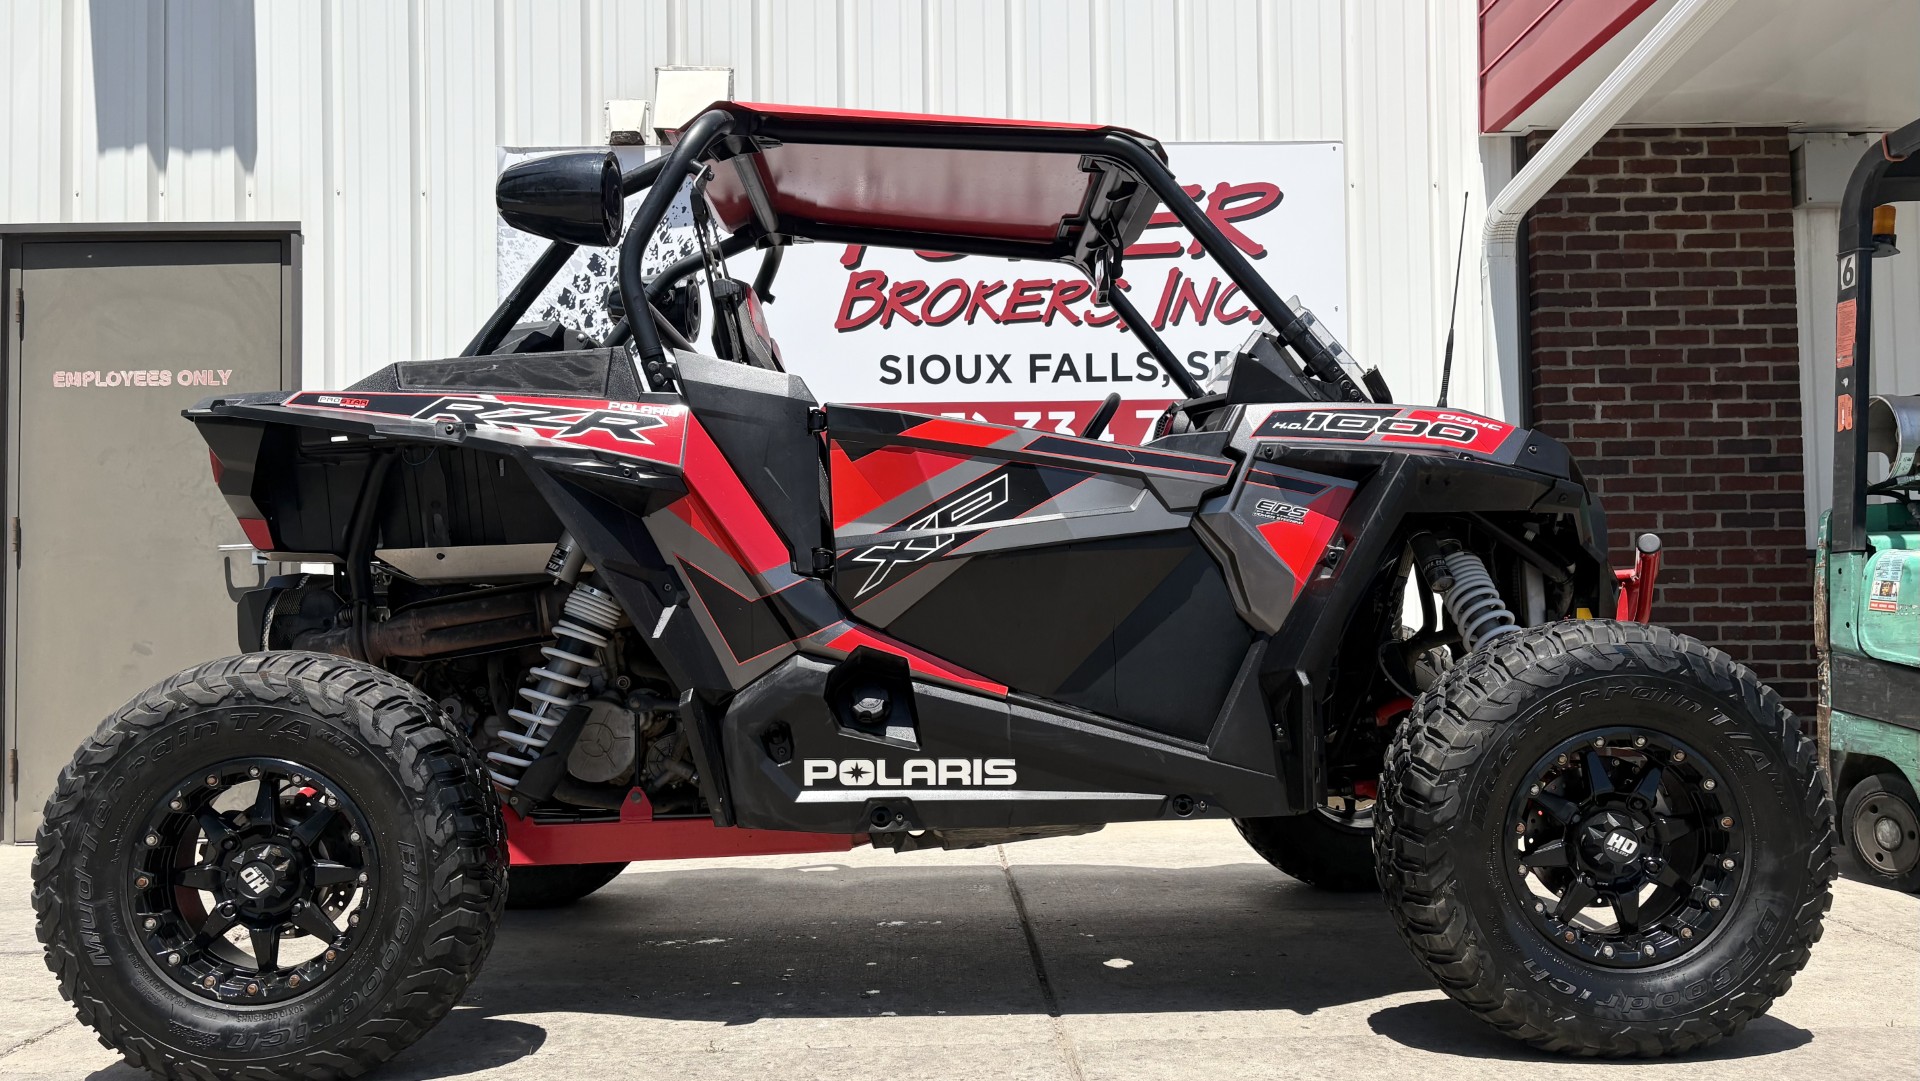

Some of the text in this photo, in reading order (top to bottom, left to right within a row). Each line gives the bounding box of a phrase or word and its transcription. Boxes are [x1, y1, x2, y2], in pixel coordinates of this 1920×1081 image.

[1842, 257, 1854, 286] 6
[53, 369, 232, 387] EMPLOYEES ONLY
[879, 353, 1013, 385] SIOUX
[1029, 351, 1171, 388] FALLS,
[410, 396, 668, 445] RZR
[1272, 412, 1503, 443] H.O. 1000 DOHC
[1255, 499, 1309, 518] EPS
[230, 712, 312, 740] T/A
[803, 759, 1018, 786] POLARIS
[1607, 832, 1637, 854] HD
[240, 867, 270, 894] HD
